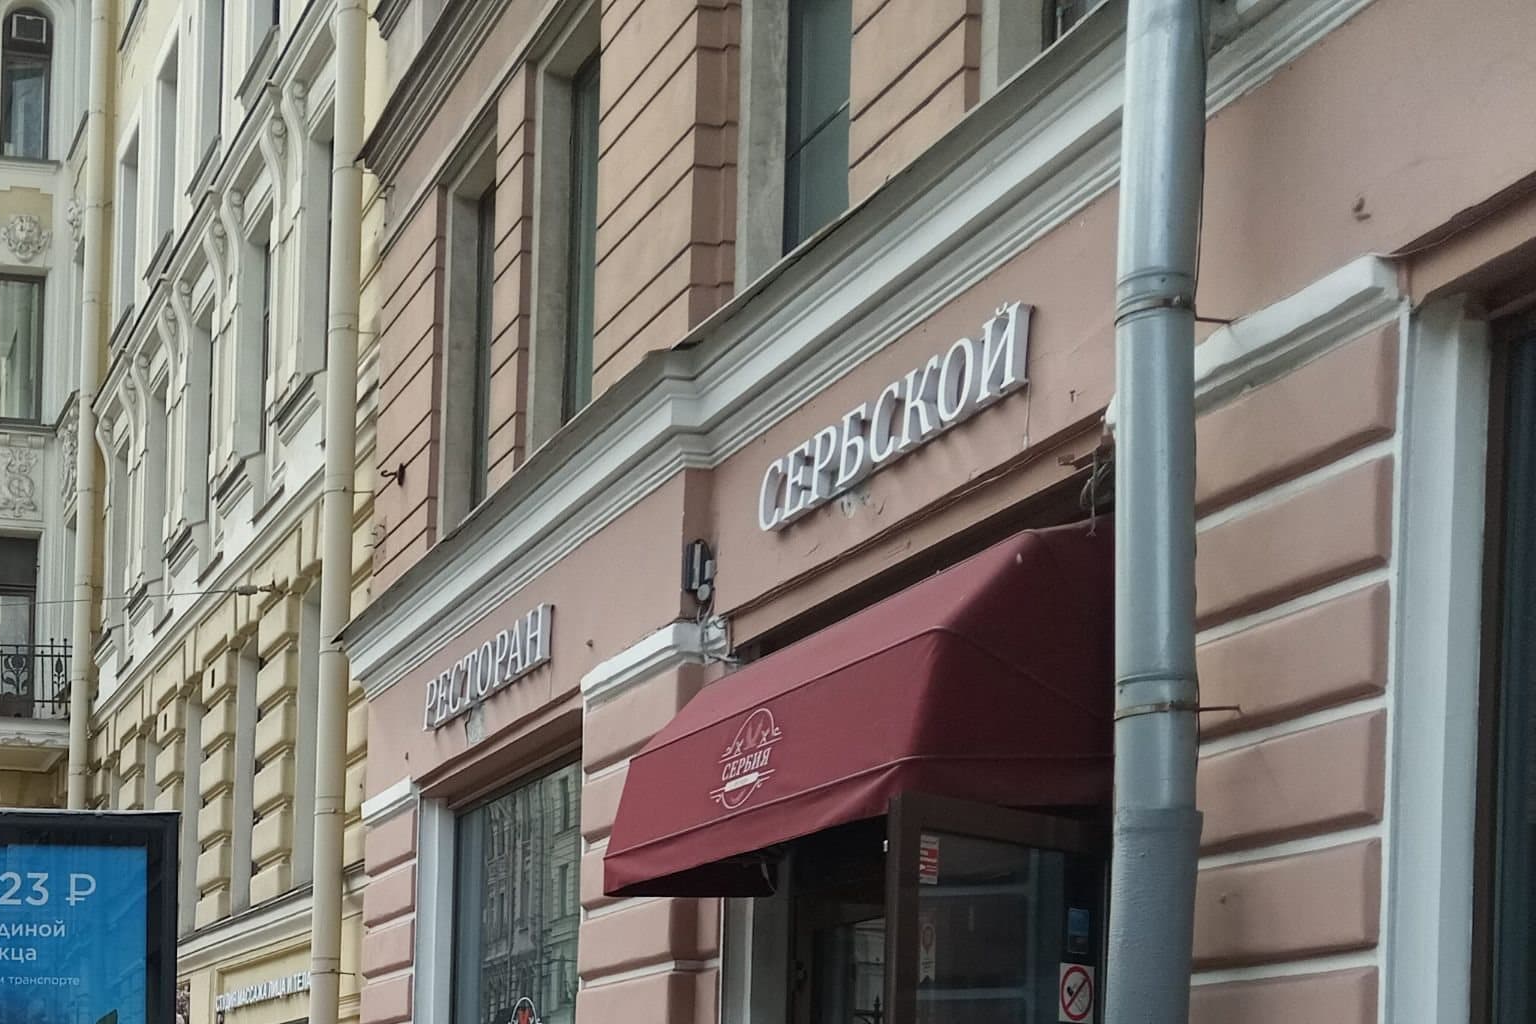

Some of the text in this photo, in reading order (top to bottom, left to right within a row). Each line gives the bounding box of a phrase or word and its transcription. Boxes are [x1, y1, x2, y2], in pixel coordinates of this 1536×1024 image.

[758, 300, 1035, 531] СЕРБСКОЙ
[422, 603, 553, 731] РЕСТОРАН
[721, 746, 773, 781] СЕРБИЯ
[9, 975, 81, 987] транспорте
